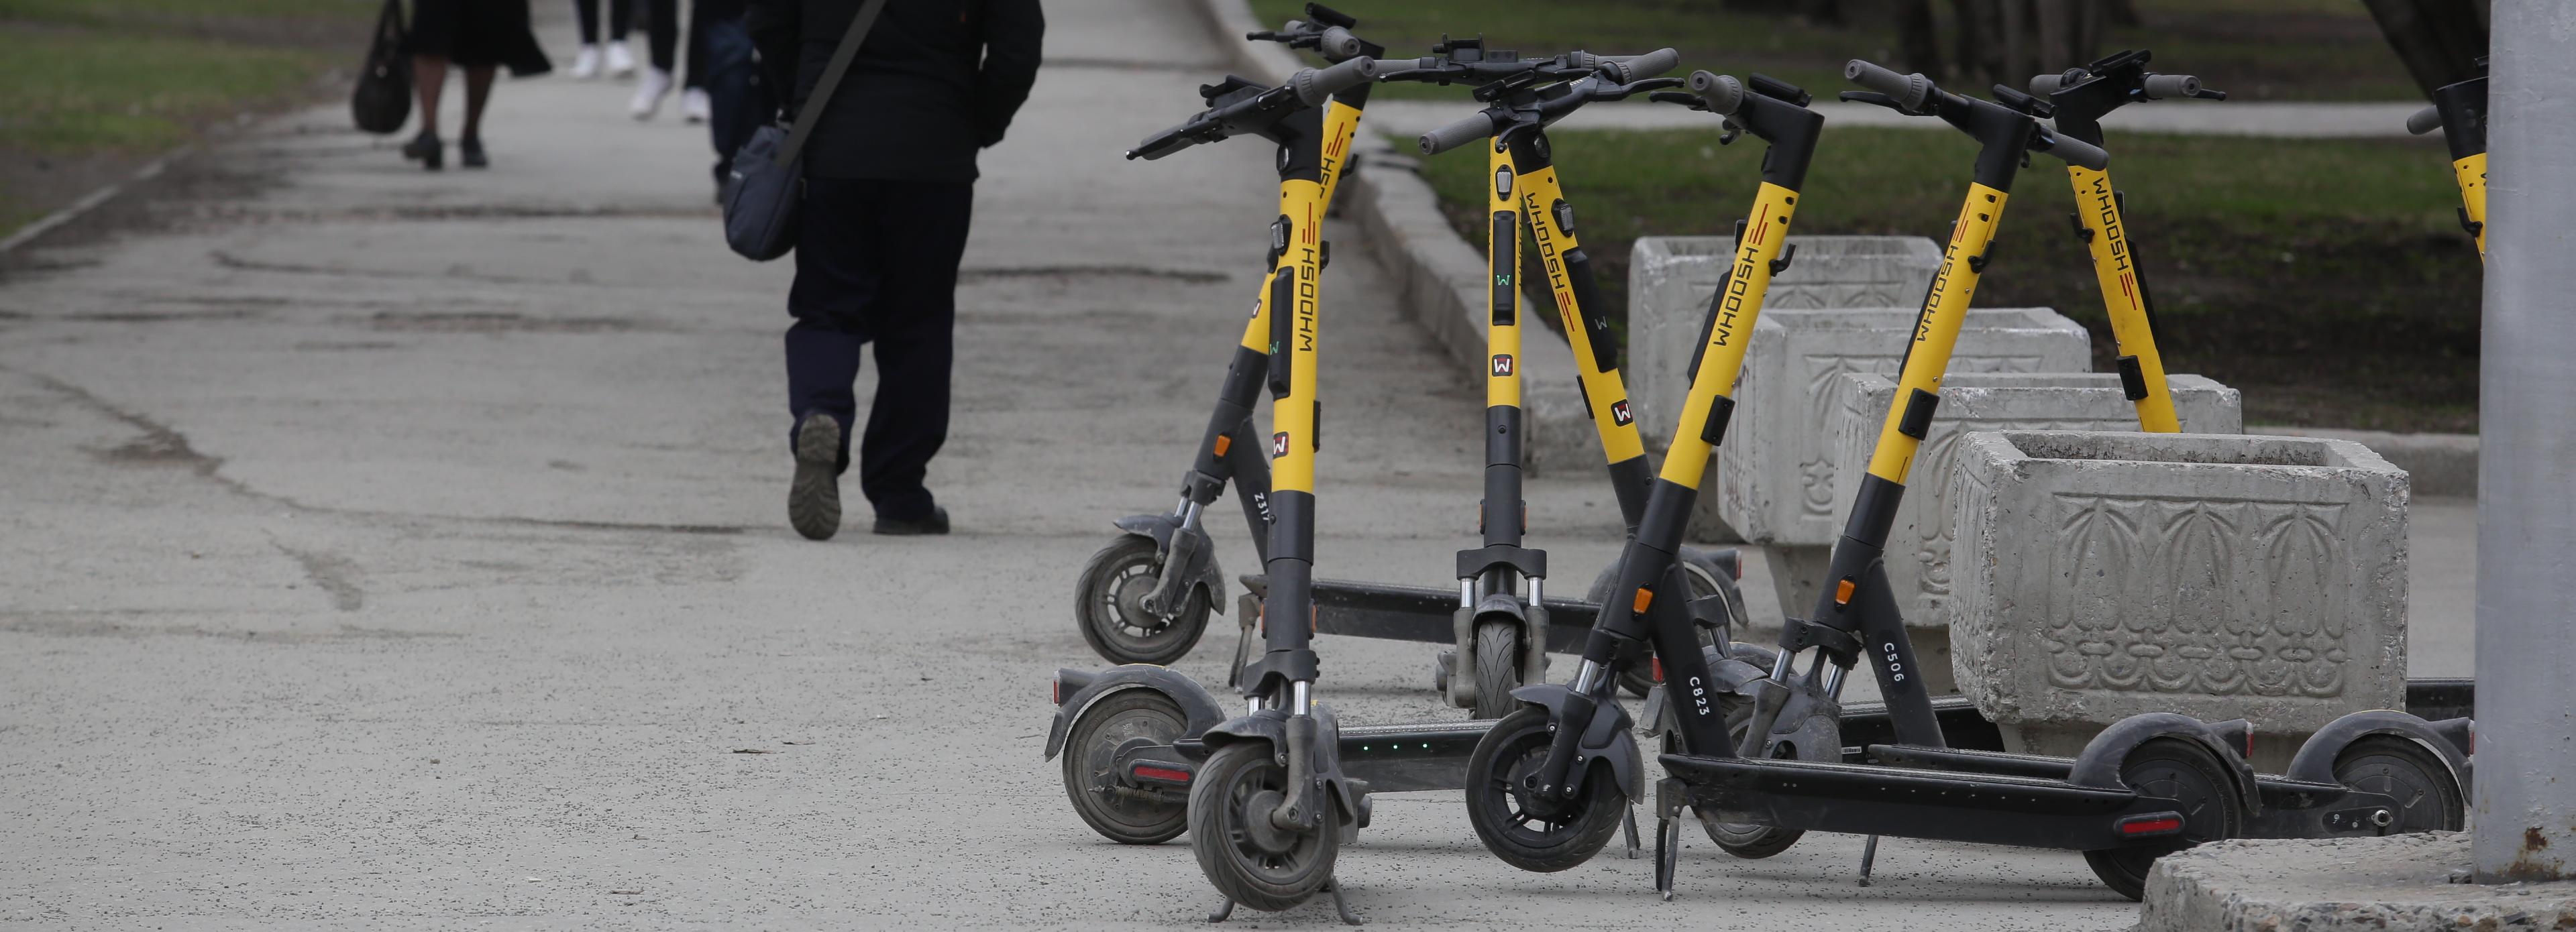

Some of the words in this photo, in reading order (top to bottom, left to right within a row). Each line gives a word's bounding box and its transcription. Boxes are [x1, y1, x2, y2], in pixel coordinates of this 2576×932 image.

[1526, 192, 1565, 289] WHOOSH
[2092, 177, 2129, 272] WHOOSH
[1299, 247, 1315, 352] WHOOSH
[1497, 274, 1511, 286] W
[1713, 246, 1759, 347] WHOOSH
[1917, 245, 1959, 342] WHOOSH
[1595, 315, 1608, 331] W
[1269, 341, 1280, 356] W
[1494, 358, 1510, 373] W
[1614, 403, 1631, 422] W
[1273, 436, 1286, 455] W
[1884, 642, 1904, 682] C506
[1689, 676, 1710, 715] C823
